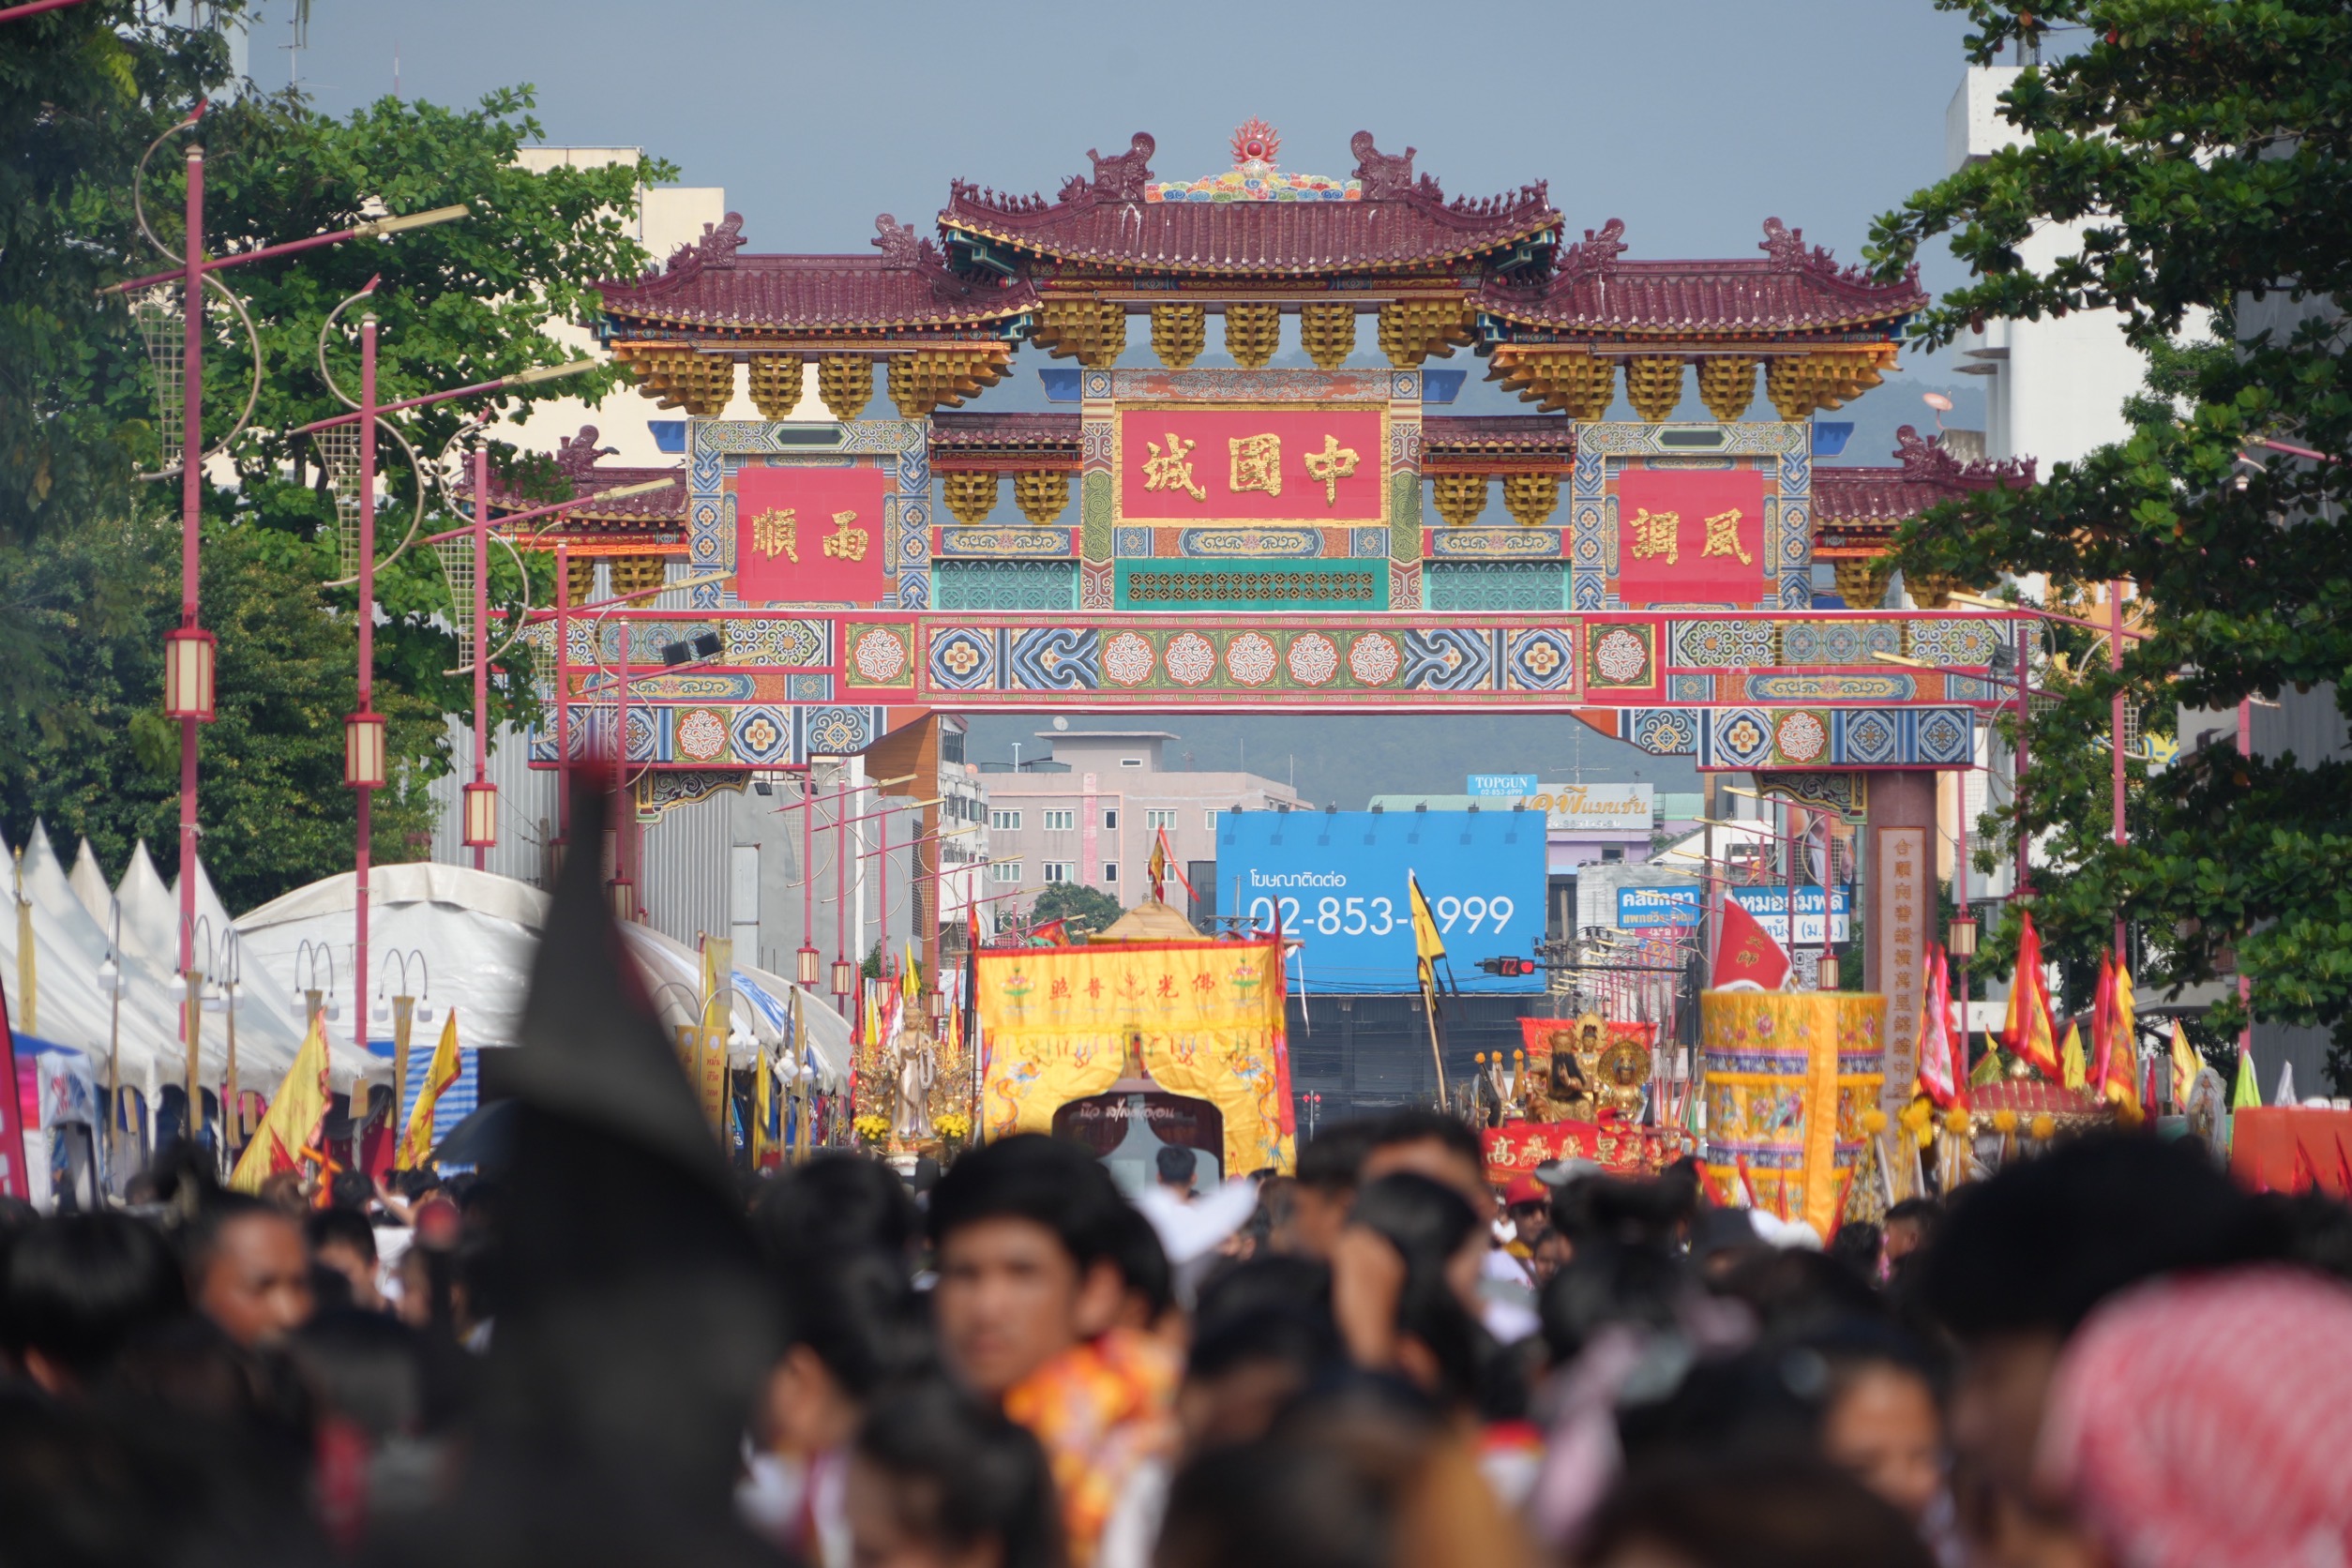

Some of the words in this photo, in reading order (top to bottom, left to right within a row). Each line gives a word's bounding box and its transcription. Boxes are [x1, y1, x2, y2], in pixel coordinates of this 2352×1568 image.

[1141, 432, 1361, 508] 中國城
[1475, 776, 1528, 789] TOPGUN
[1250, 868, 1347, 887] โฆษณาติดต่อ
[1622, 889, 1695, 907] คลนิกตา
[1249, 896, 1515, 936] 02-853-999
[1502, 959, 1518, 975] 72
